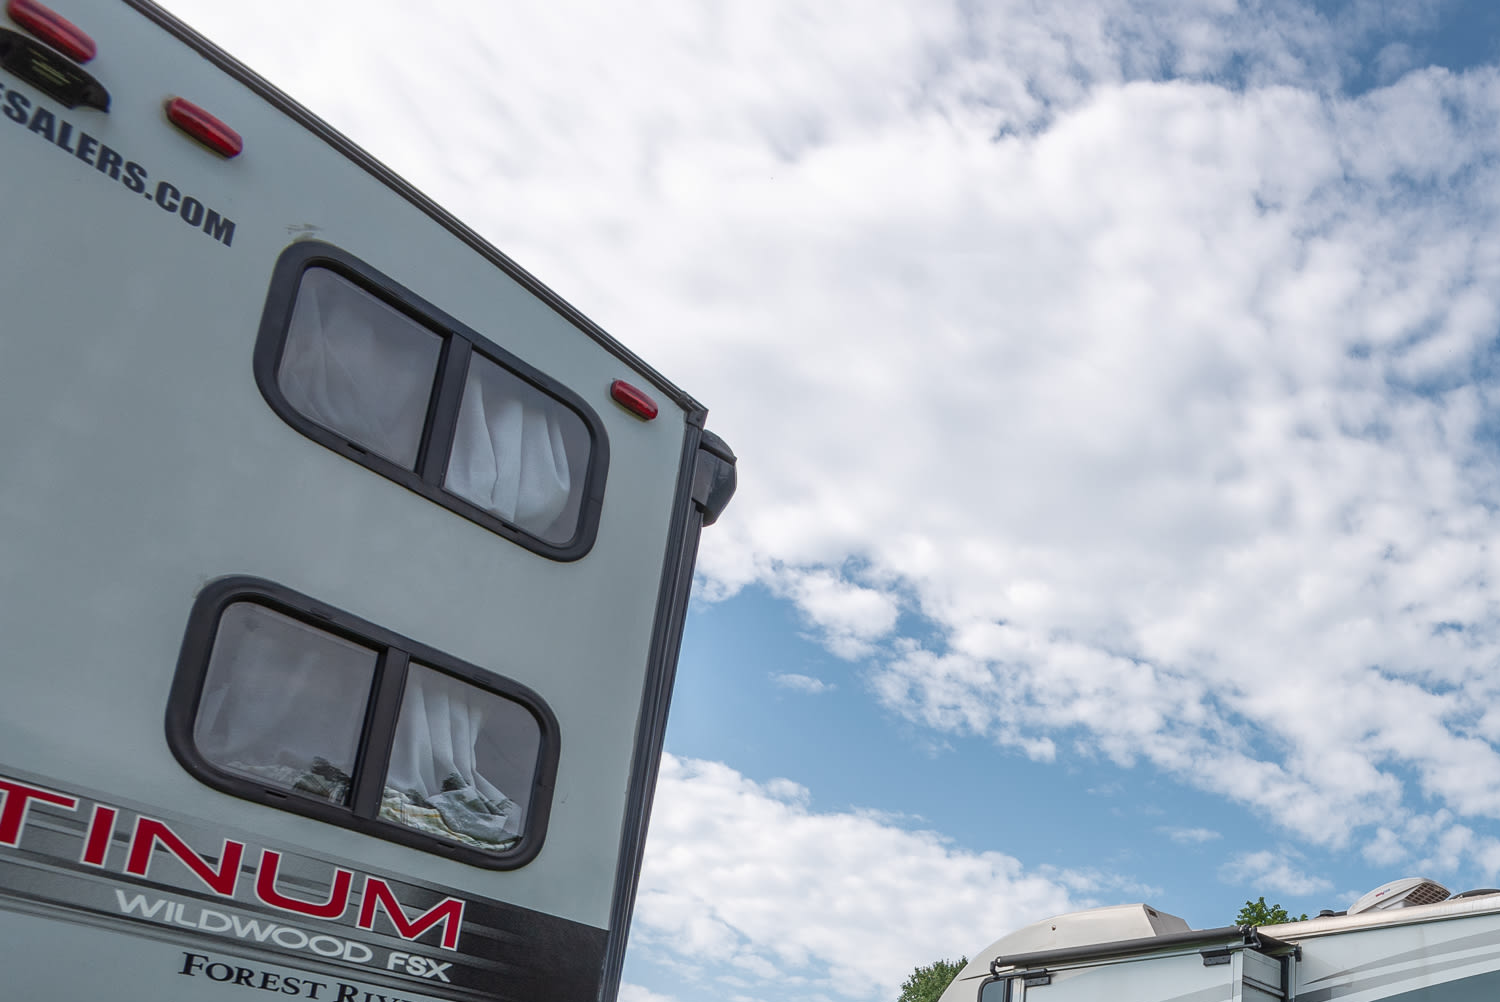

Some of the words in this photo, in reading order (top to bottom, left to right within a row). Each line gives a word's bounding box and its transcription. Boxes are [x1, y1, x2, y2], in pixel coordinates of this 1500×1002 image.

[0, 83, 236, 247] SALERS.COM
[0, 777, 464, 951] TINUM
[115, 889, 373, 963] WILDWOOD
[387, 953, 452, 982] FSX
[178, 952, 327, 1000] FOREST
